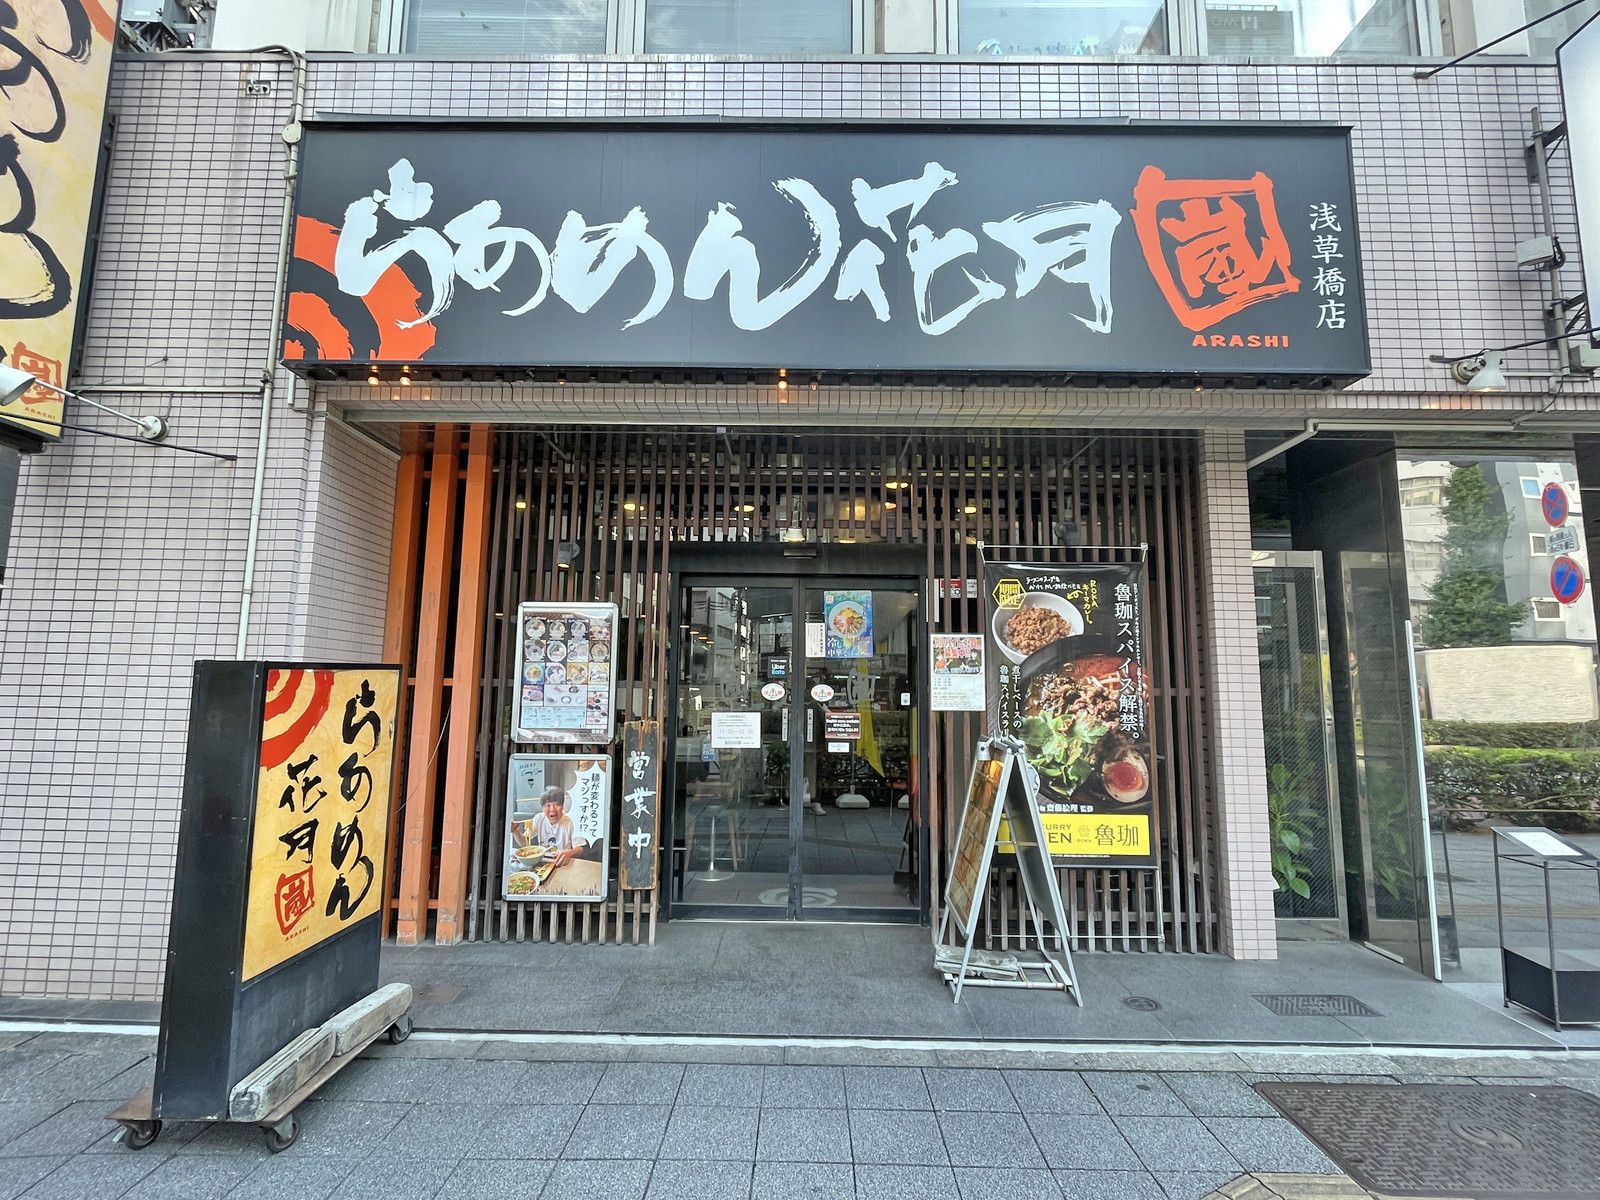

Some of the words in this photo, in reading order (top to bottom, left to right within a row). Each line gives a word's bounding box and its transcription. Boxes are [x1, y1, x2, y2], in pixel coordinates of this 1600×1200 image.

[1309, 202, 1346, 331] 浅草橋店
[1192, 333, 1290, 348] ARASHI
[24, 406, 56, 420] ARASHI
[999, 583, 1020, 596] 期間
[1089, 579, 1099, 608] ROKA
[1114, 582, 1140, 739] 魯珈スパイス解禁。
[1011, 665, 1022, 728] 煮干しベースの
[325, 678, 382, 921] らあめん
[589, 773, 600, 838] 麺が変わるって
[624, 749, 657, 860] 営業中
[1042, 823, 1072, 831] URRY
[1094, 823, 1139, 847] 魯珈
[284, 925, 310, 942] ARASHI
